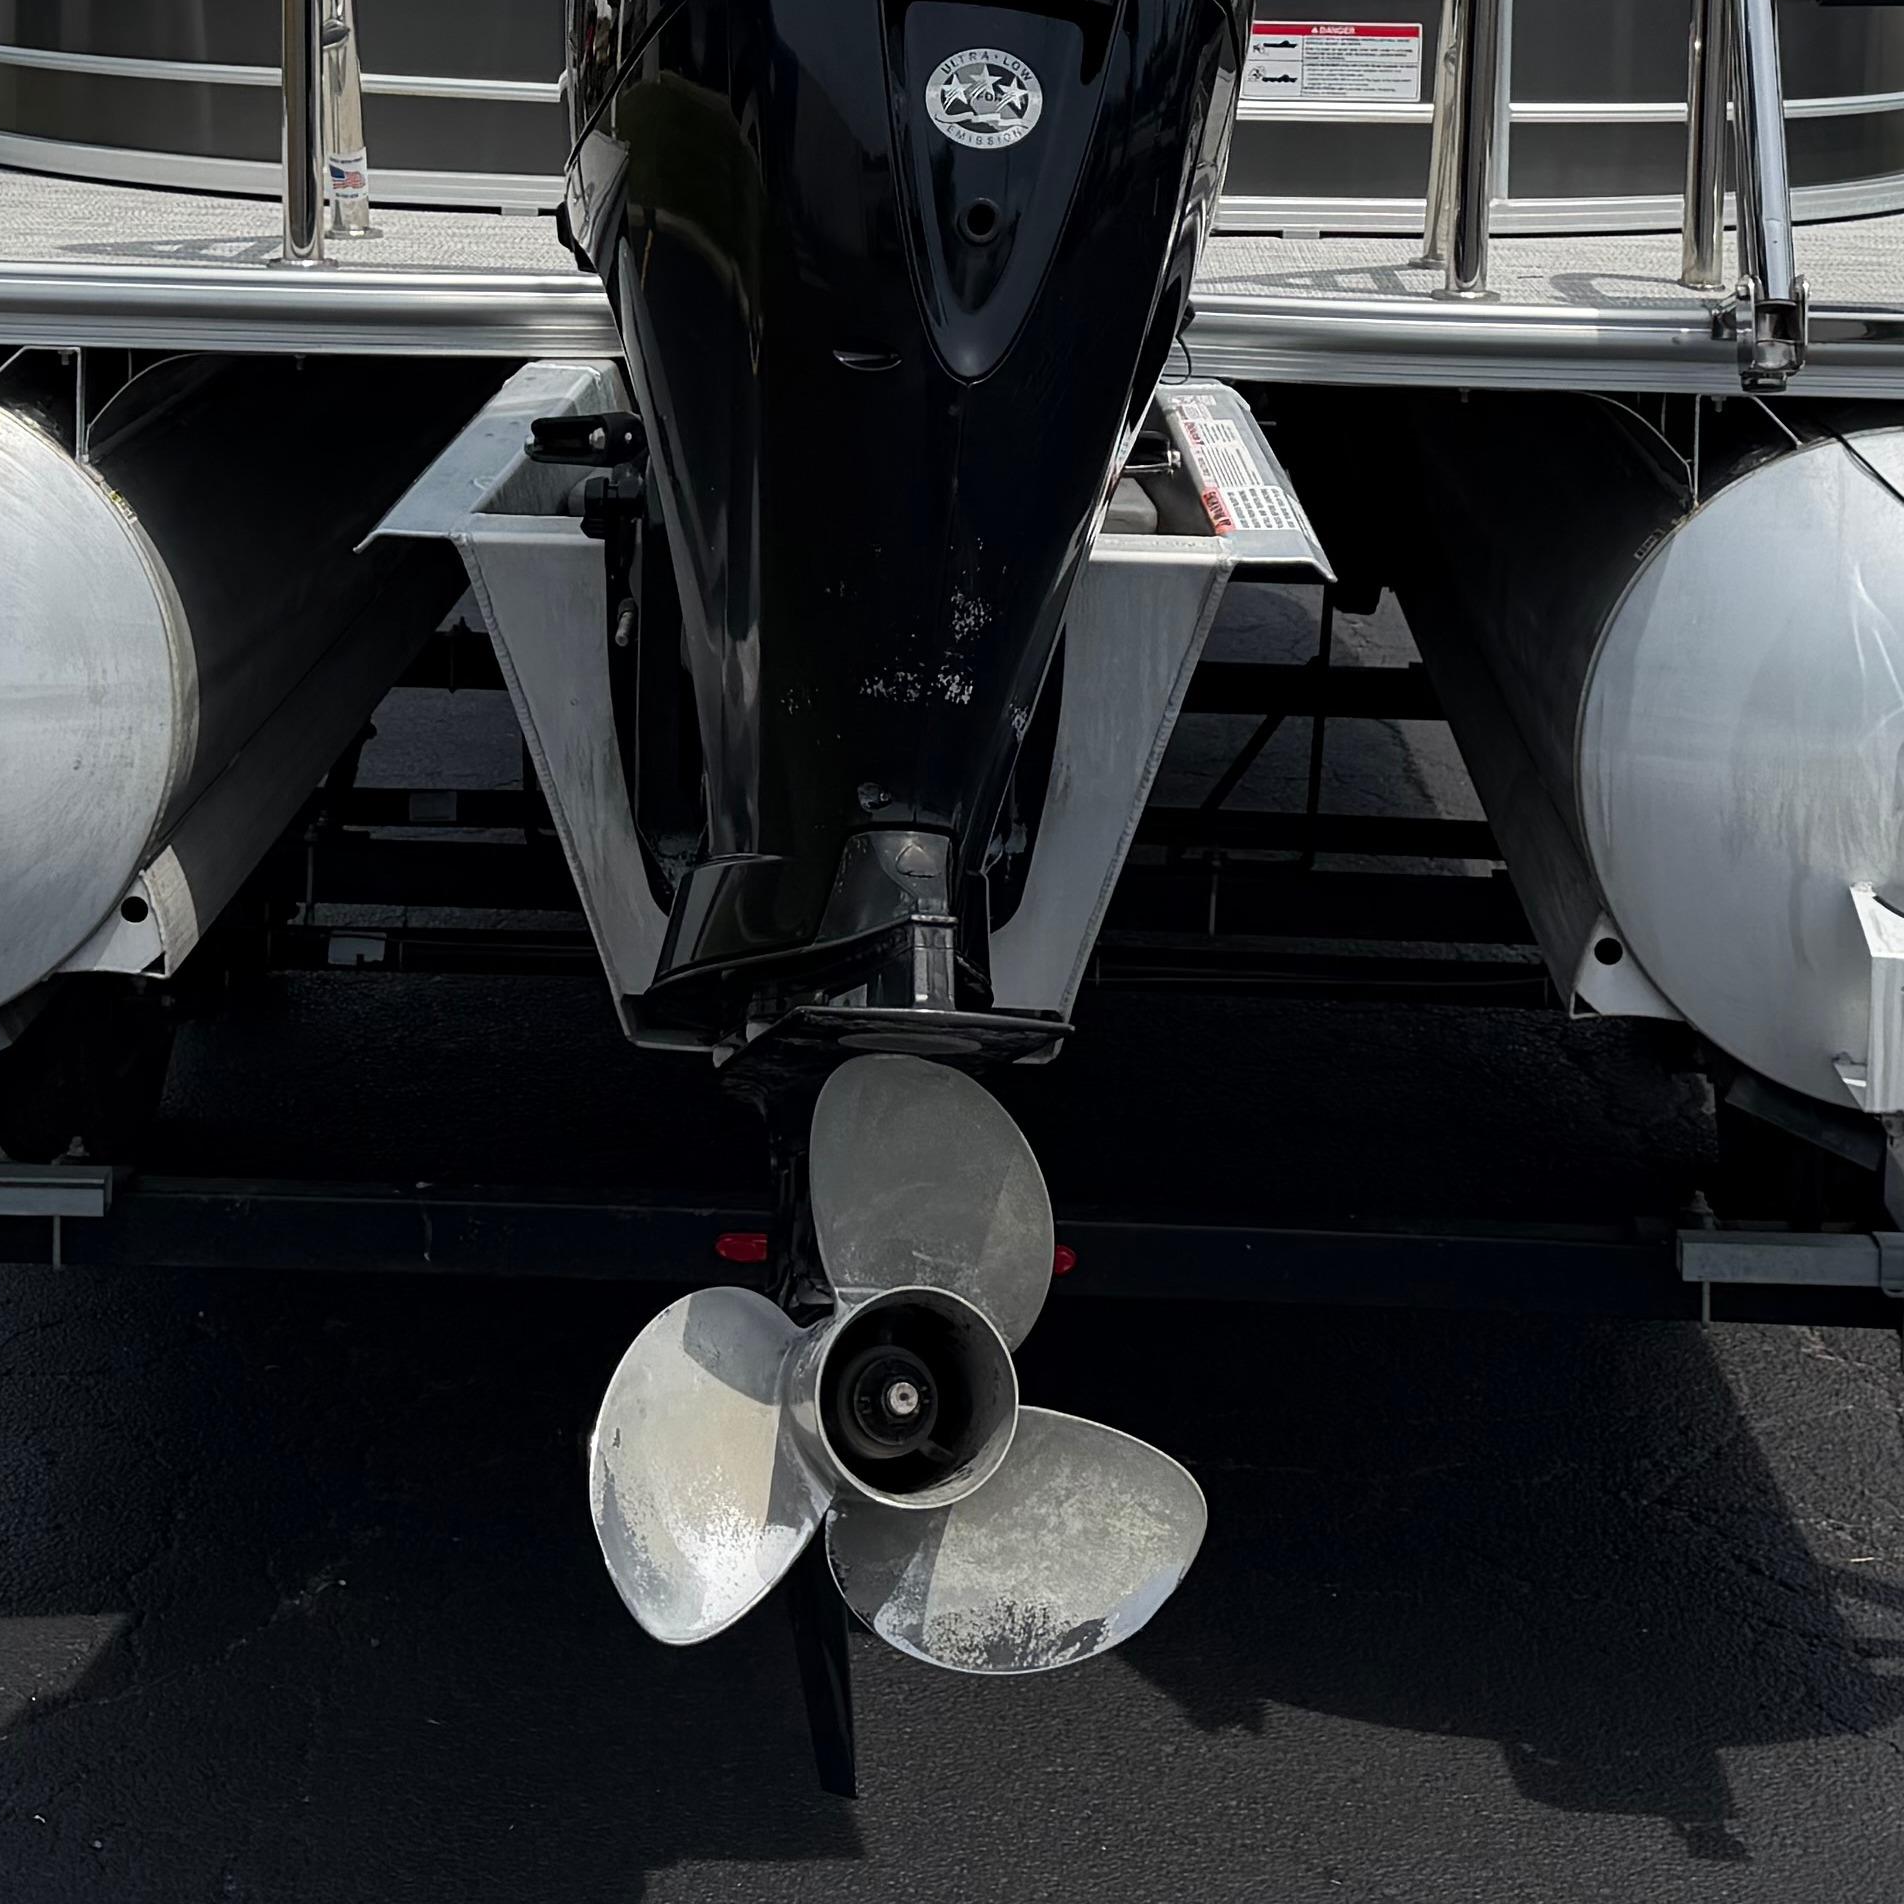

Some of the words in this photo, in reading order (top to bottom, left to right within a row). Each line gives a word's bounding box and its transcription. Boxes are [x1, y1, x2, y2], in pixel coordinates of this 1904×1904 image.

[1319, 27, 1356, 35] DANGER
[940, 51, 989, 75] ULTRA
[1002, 57, 1032, 81] LOW
[946, 124, 1022, 146] EMISSION
